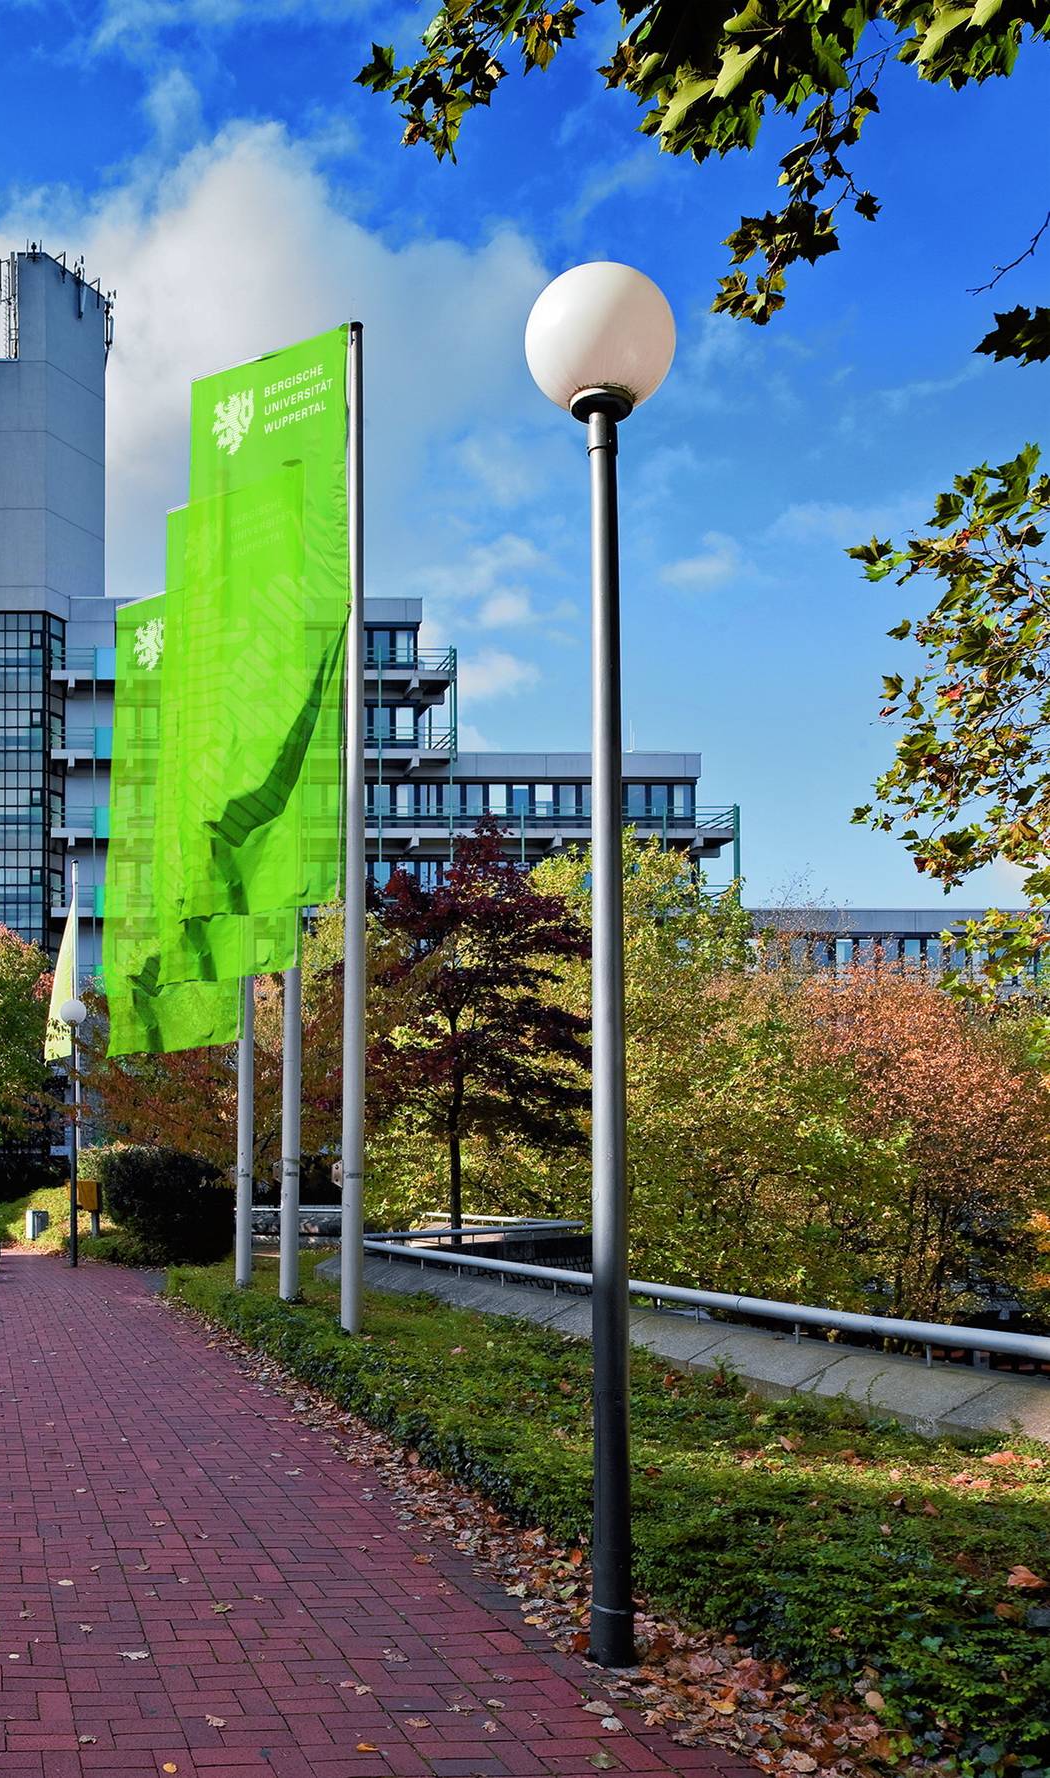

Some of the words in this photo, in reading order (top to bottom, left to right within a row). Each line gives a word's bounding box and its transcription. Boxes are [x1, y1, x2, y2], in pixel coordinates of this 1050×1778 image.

[264, 364, 323, 398] BERGISCHE
[264, 378, 334, 416] UNIVERSITÄT
[263, 400, 327, 434] WUPPERTAL
